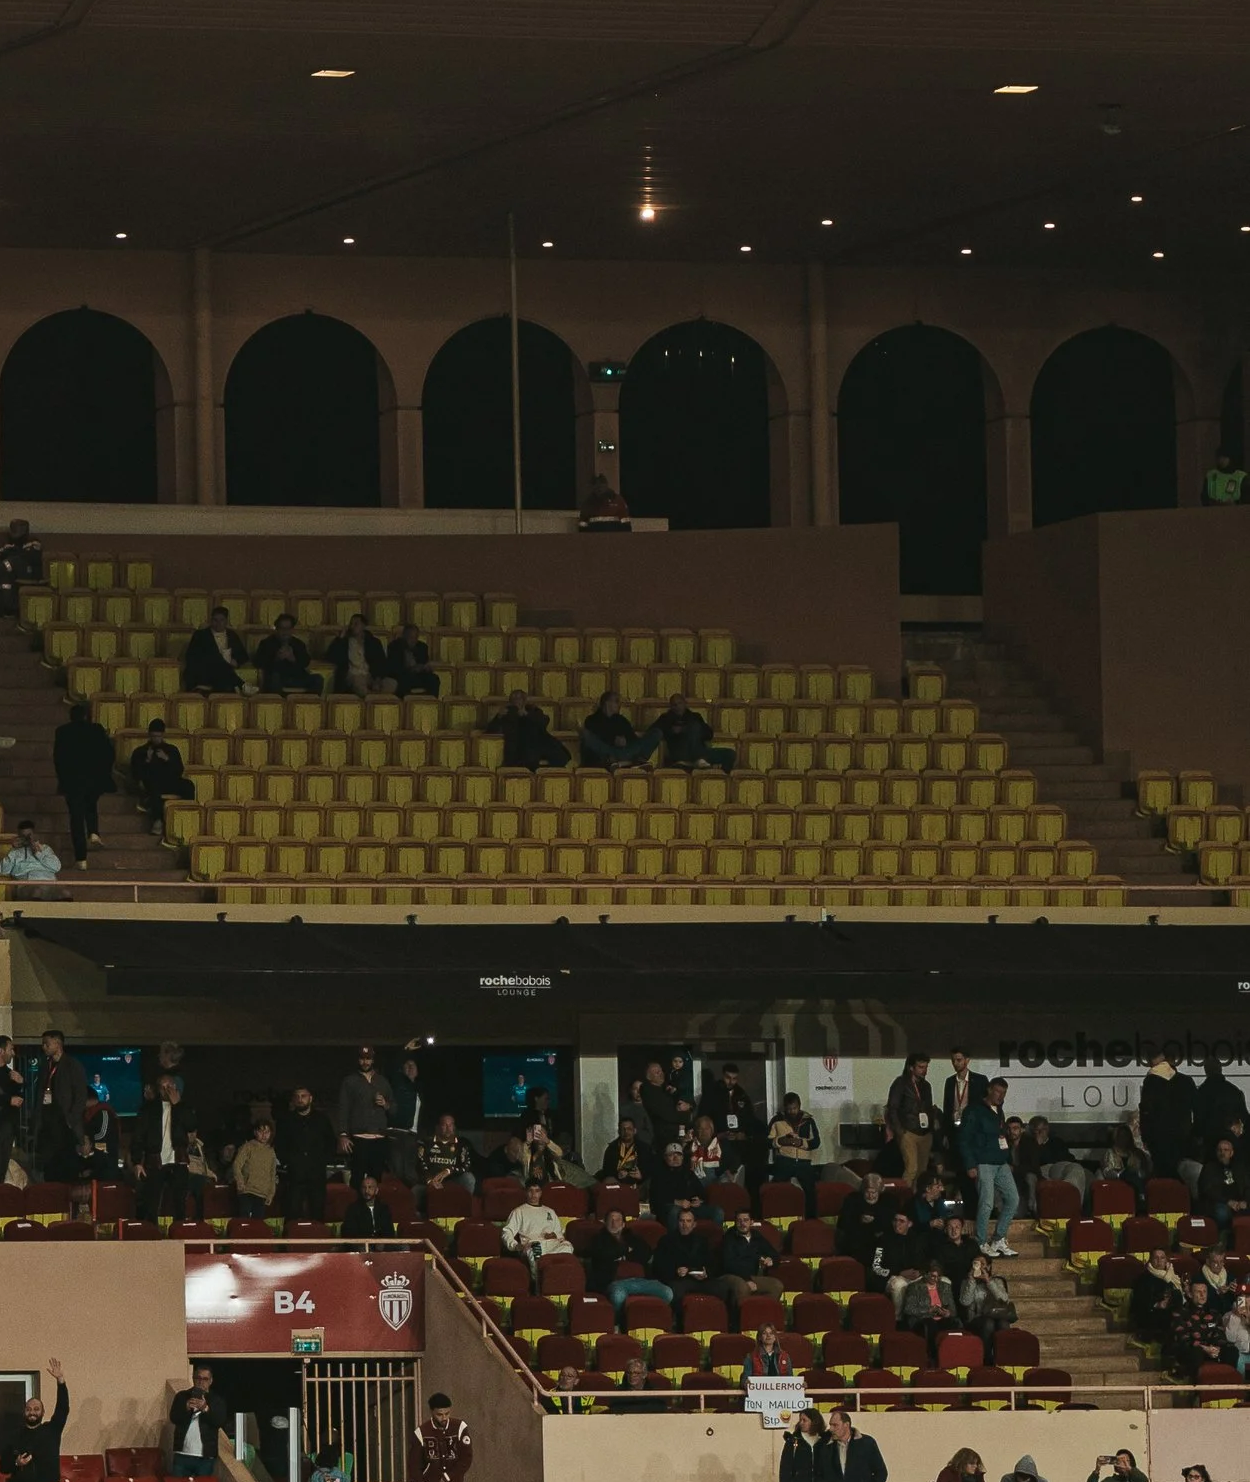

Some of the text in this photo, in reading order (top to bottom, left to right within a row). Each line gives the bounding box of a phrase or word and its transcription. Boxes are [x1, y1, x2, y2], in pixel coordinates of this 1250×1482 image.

[479, 975, 551, 986] rochebobois
[1060, 1085, 1129, 1108] LOU
[274, 1290, 315, 1314] B4
[749, 1382, 802, 1391] GUILLERMO
[769, 1400, 810, 1409] MAILLOT
[764, 1415, 780, 1425] Stp
